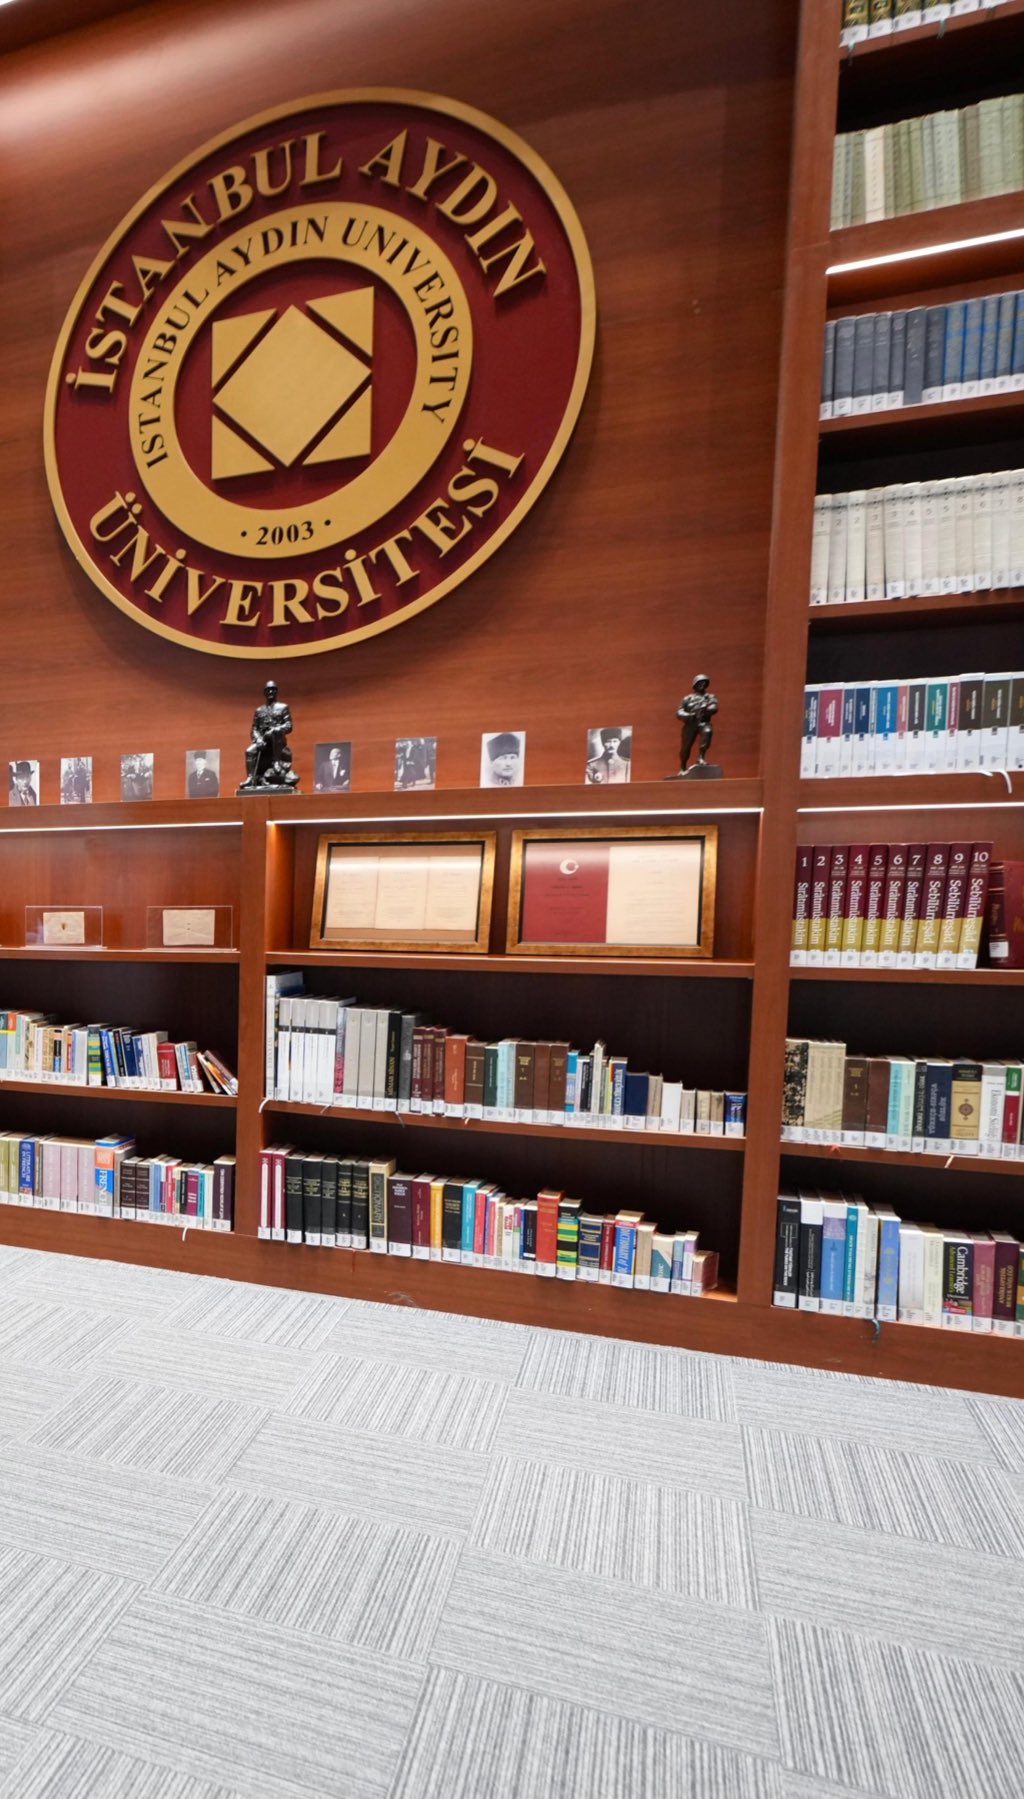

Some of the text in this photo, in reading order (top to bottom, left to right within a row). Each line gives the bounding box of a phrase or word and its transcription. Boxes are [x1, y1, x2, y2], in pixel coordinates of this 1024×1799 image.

[65, 128, 548, 394] İSTANBUL AYDIN
[137, 215, 461, 469] ISTANBUL AYDIN UNIVERSITY
[88, 436, 527, 629] ÜNİVERSİTESİ
[255, 520, 316, 547] 2003
[801, 857, 808, 867] 1
[817, 856, 825, 866] 2
[835, 855, 844, 865] 3
[854, 854, 863, 865] 4
[874, 855, 883, 865] 5
[893, 854, 903, 865] 6
[912, 854, 921, 865] 7
[933, 853, 943, 864] 8
[954, 852, 964, 863] 9
[973, 851, 989, 862] 10
[954, 1246, 969, 1294] Cambridge
